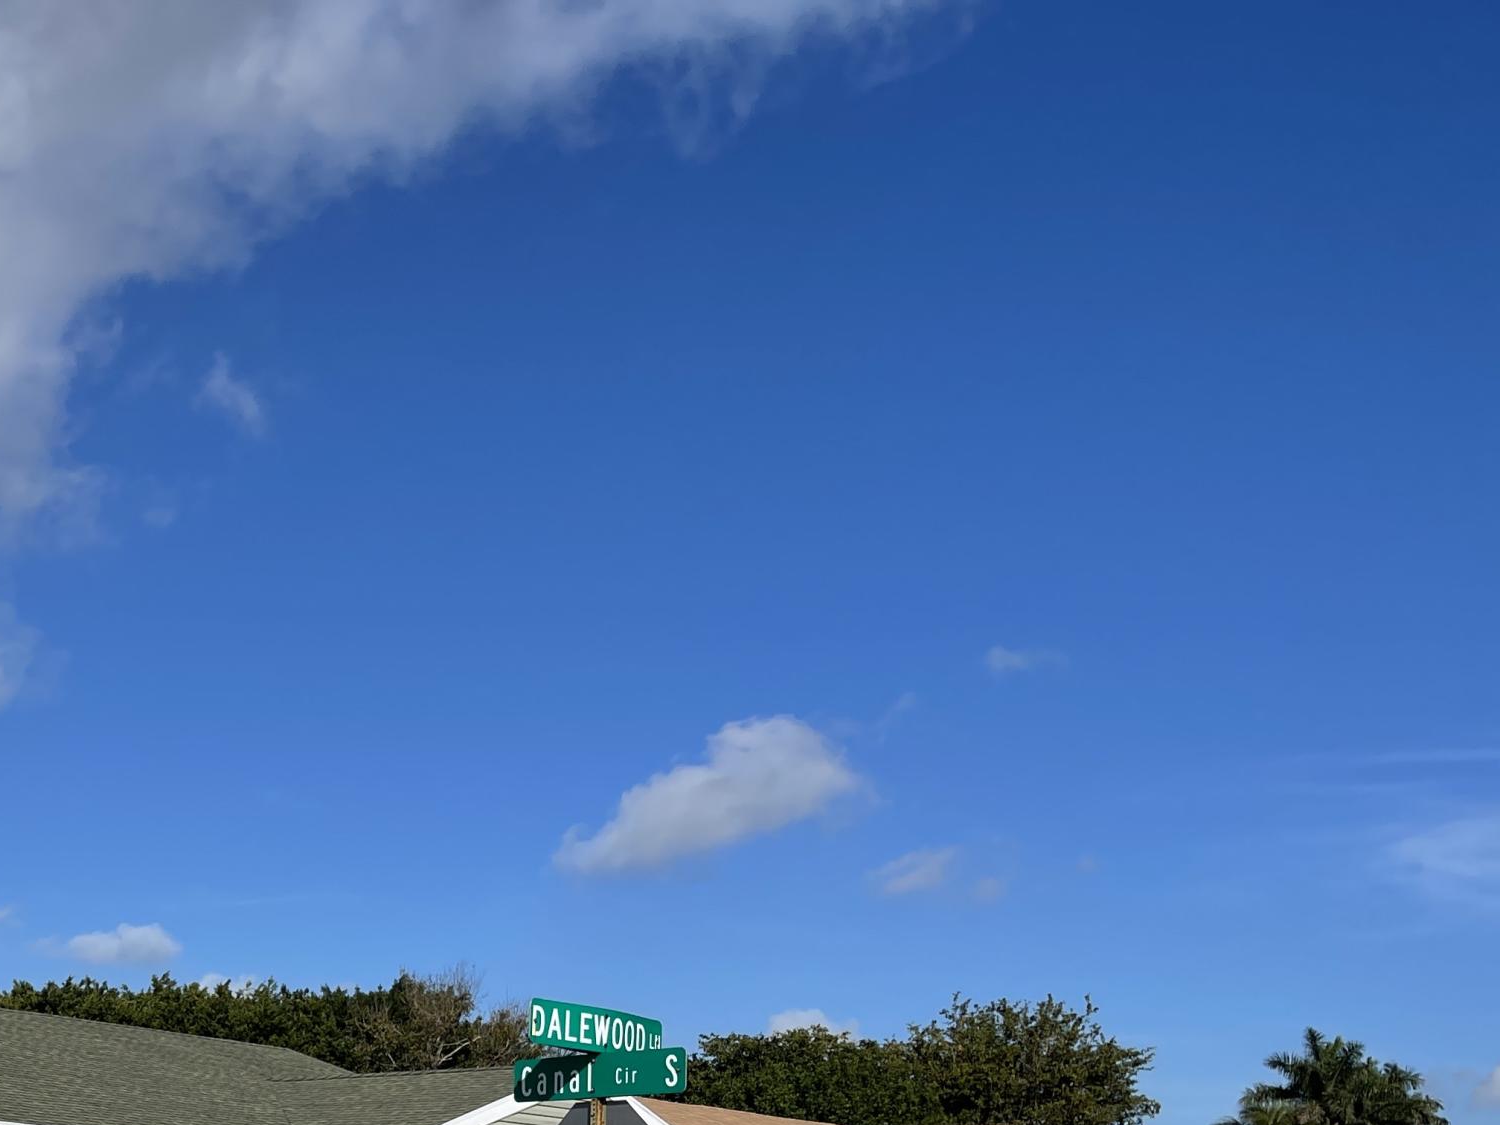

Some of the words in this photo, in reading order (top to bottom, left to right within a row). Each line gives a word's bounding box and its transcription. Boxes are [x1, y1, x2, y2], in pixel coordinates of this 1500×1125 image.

[531, 1004, 646, 1052] DALEWOOD
[521, 1062, 593, 1097] Canal
[615, 1067, 637, 1085] Cir
[665, 1054, 678, 1087] S
